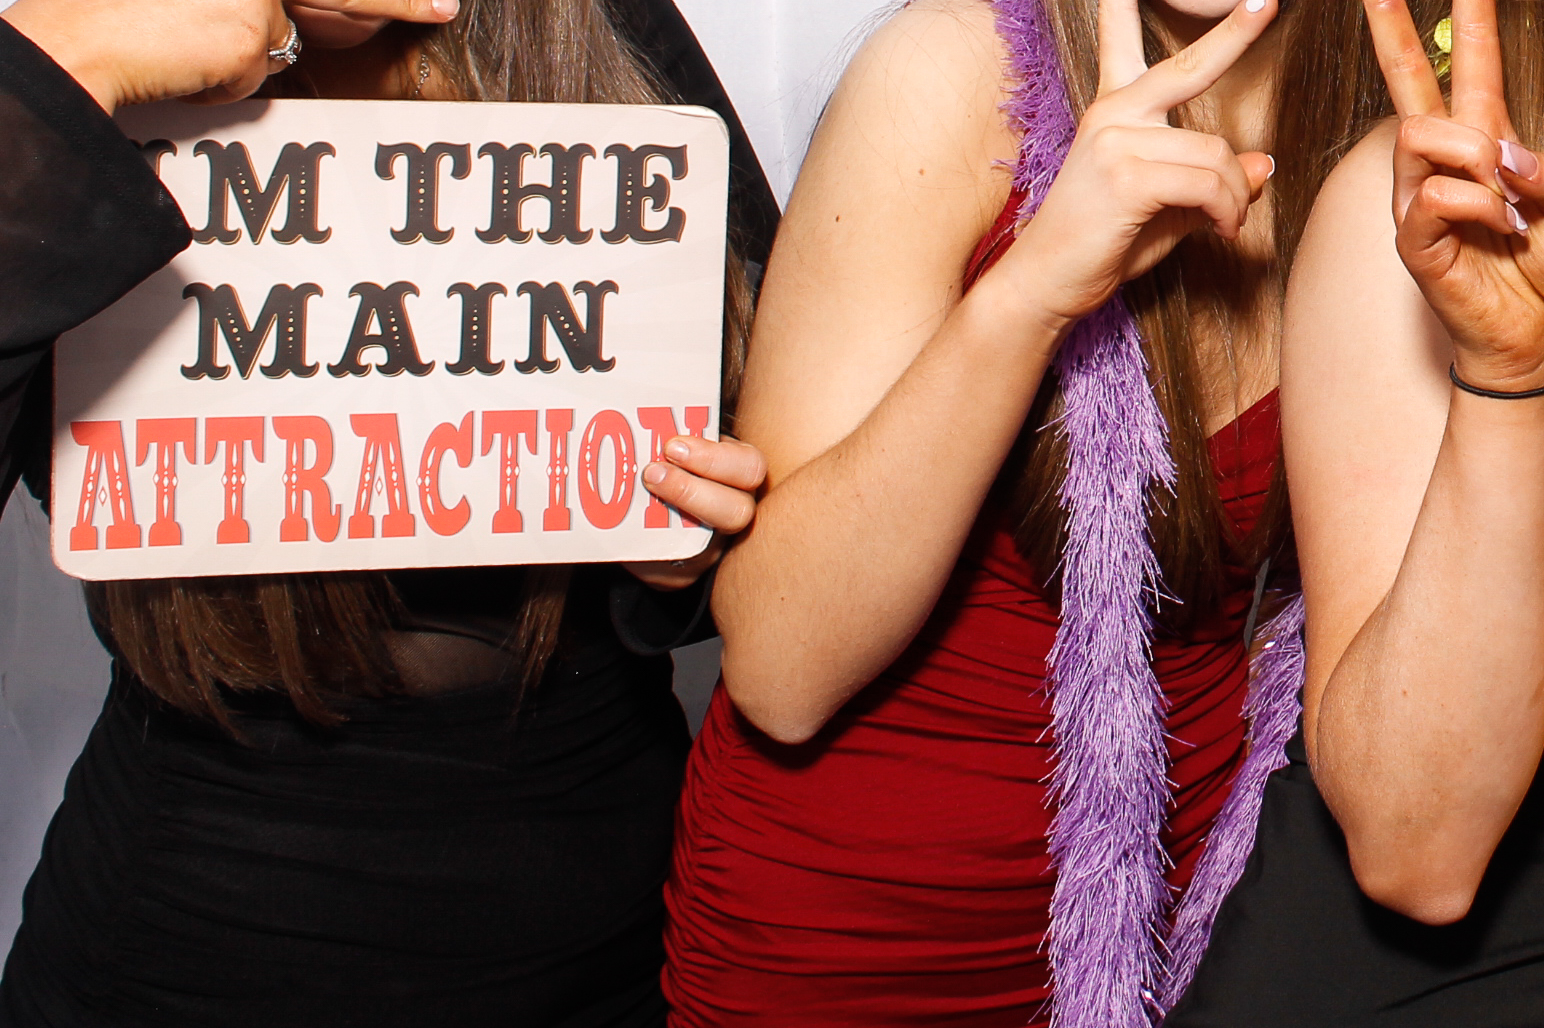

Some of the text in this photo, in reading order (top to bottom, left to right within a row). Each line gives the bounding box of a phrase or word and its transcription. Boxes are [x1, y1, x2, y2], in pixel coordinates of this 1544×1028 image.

[124, 138, 689, 245] M THE
[180, 279, 619, 381] MAIN
